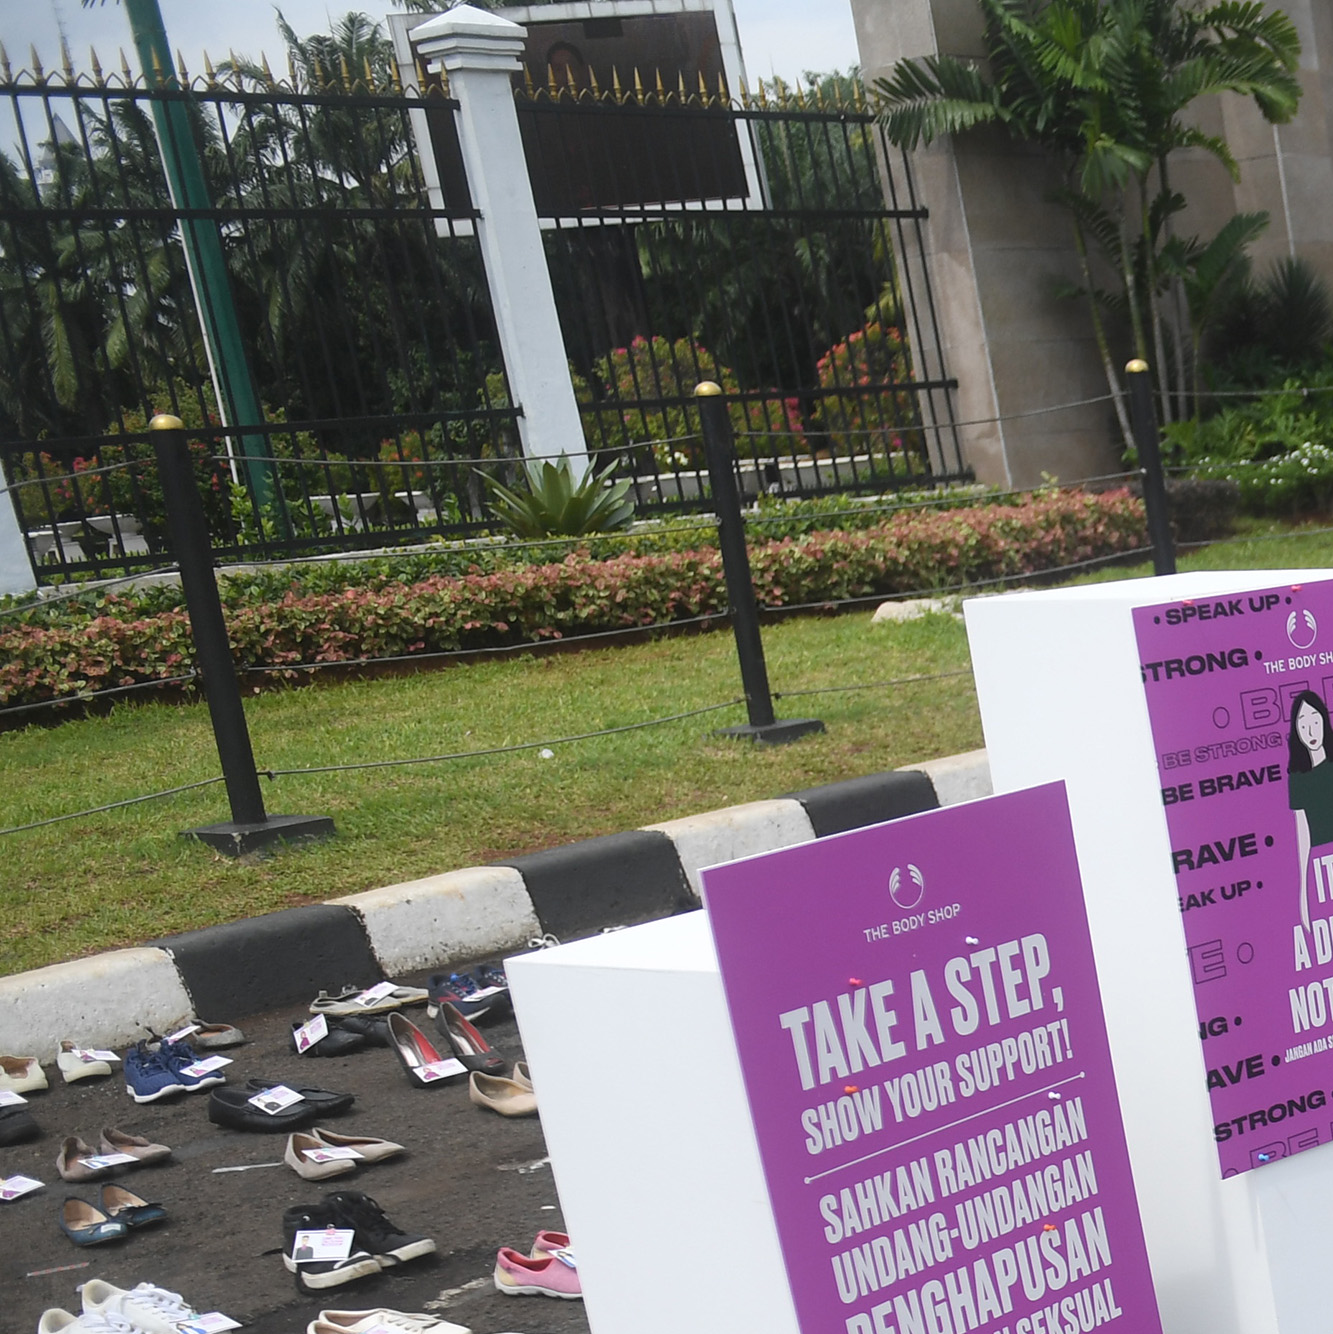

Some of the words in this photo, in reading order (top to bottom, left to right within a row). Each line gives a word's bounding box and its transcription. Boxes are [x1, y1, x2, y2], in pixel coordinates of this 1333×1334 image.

[1165, 599, 1244, 626] SPEAK
[1248, 594, 1280, 612] UP
[1263, 660, 1286, 674] THE
[1289, 654, 1316, 671] BODY
[1162, 750, 1192, 770] BE
[1195, 732, 1283, 763] STRONG
[1199, 764, 1282, 797] BRAVE
[1220, 880, 1252, 900] UP
[863, 924, 889, 942] THE
[892, 913, 925, 935] BODY
[927, 903, 961, 925] SHOP
[1293, 924, 1312, 972] A
[779, 979, 906, 1091] TAKE
[910, 969, 945, 1051] A
[944, 933, 1064, 1036] STEP,
[1285, 1042, 1314, 1063] JANGAN
[1313, 1038, 1328, 1054] ADA
[801, 1085, 883, 1155] SHOW
[884, 1061, 957, 1123] YOUR
[955, 1018, 1074, 1098] SUPPORT!
[1213, 1090, 1327, 1142] STRONG
[819, 1157, 935, 1244] SAHKAN
[934, 1097, 1088, 1198] RANCANGAN
[831, 1150, 1099, 1304] UNDANG-UNDANGAN
